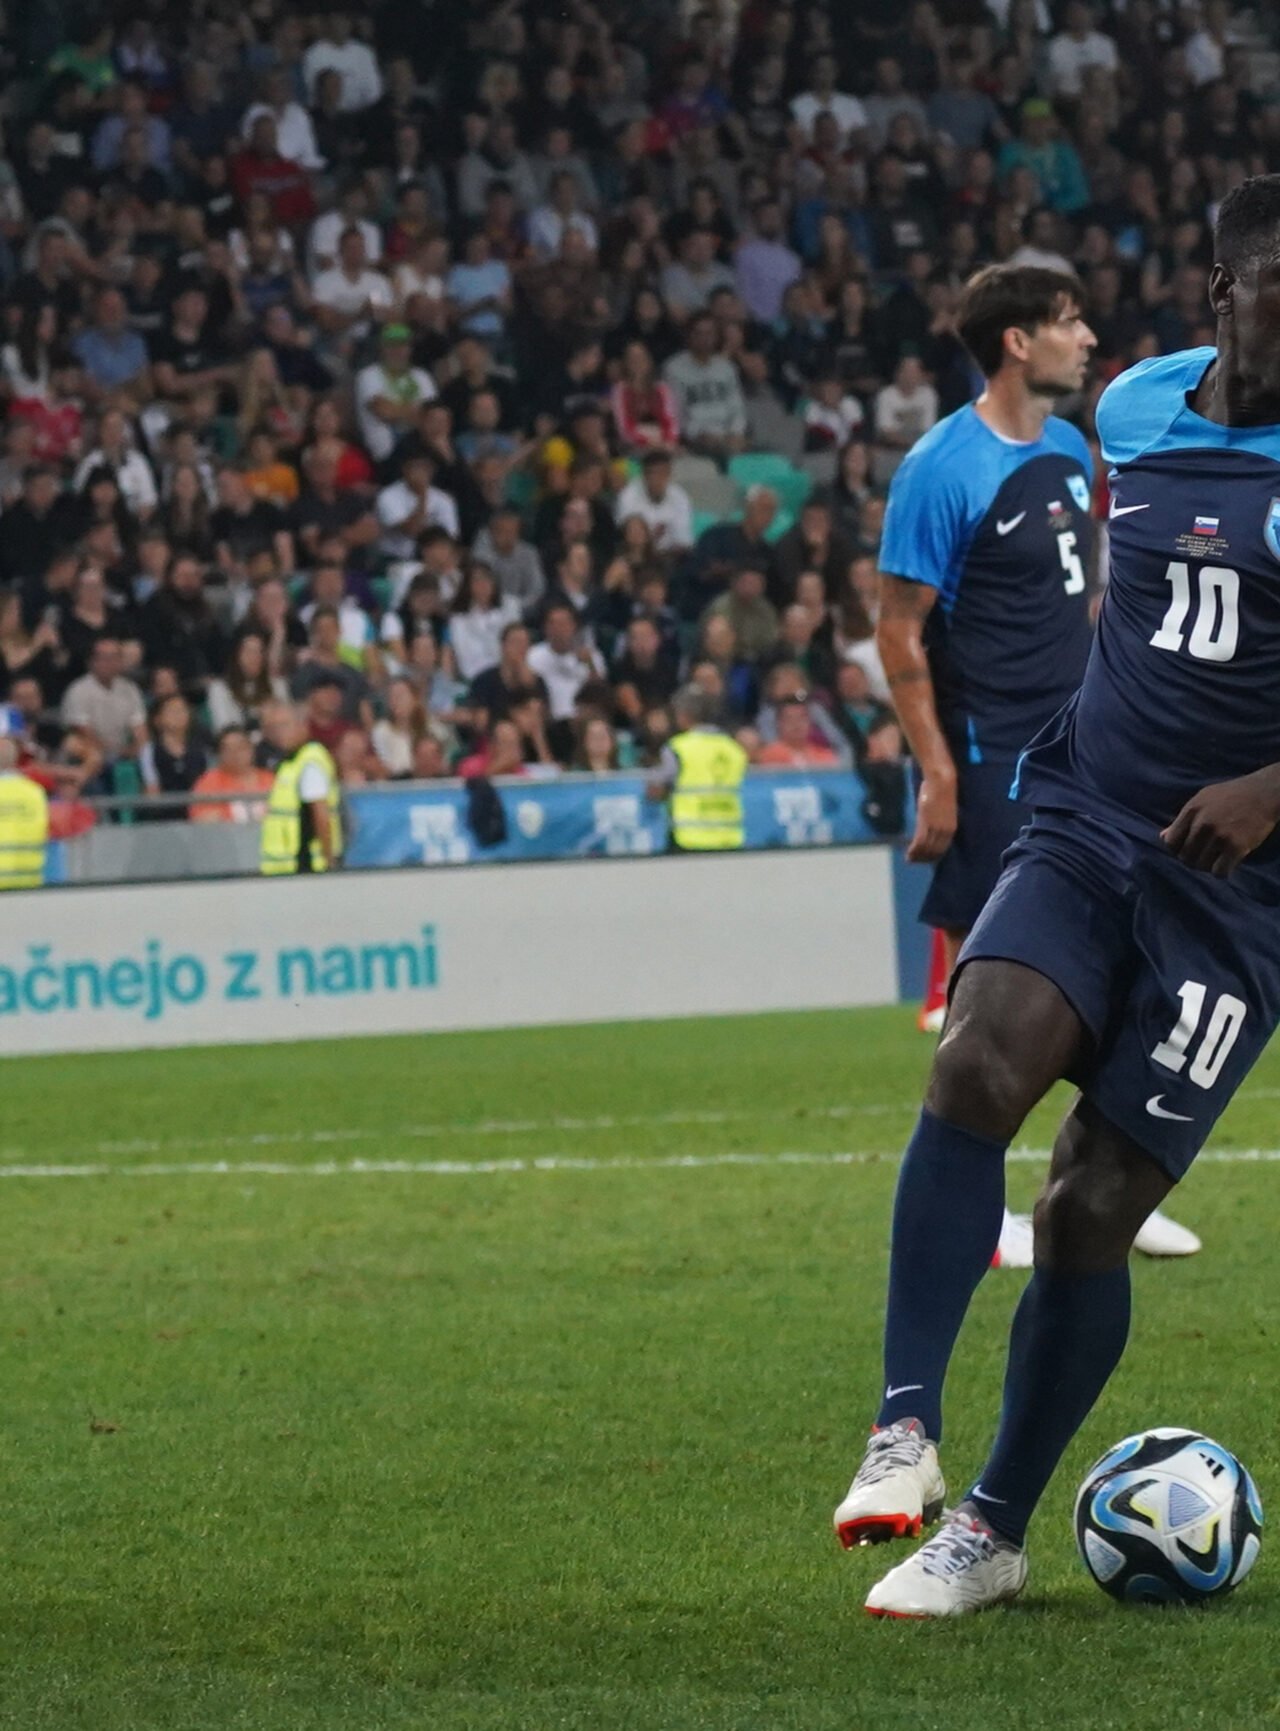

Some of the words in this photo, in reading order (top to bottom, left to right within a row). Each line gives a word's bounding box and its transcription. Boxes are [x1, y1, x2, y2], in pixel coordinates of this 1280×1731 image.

[1057, 531, 1085, 595] 5
[1149, 561, 1240, 662] 10
[225, 951, 260, 999] z
[277, 923, 437, 996] nami
[1151, 979, 1247, 1090] 10
